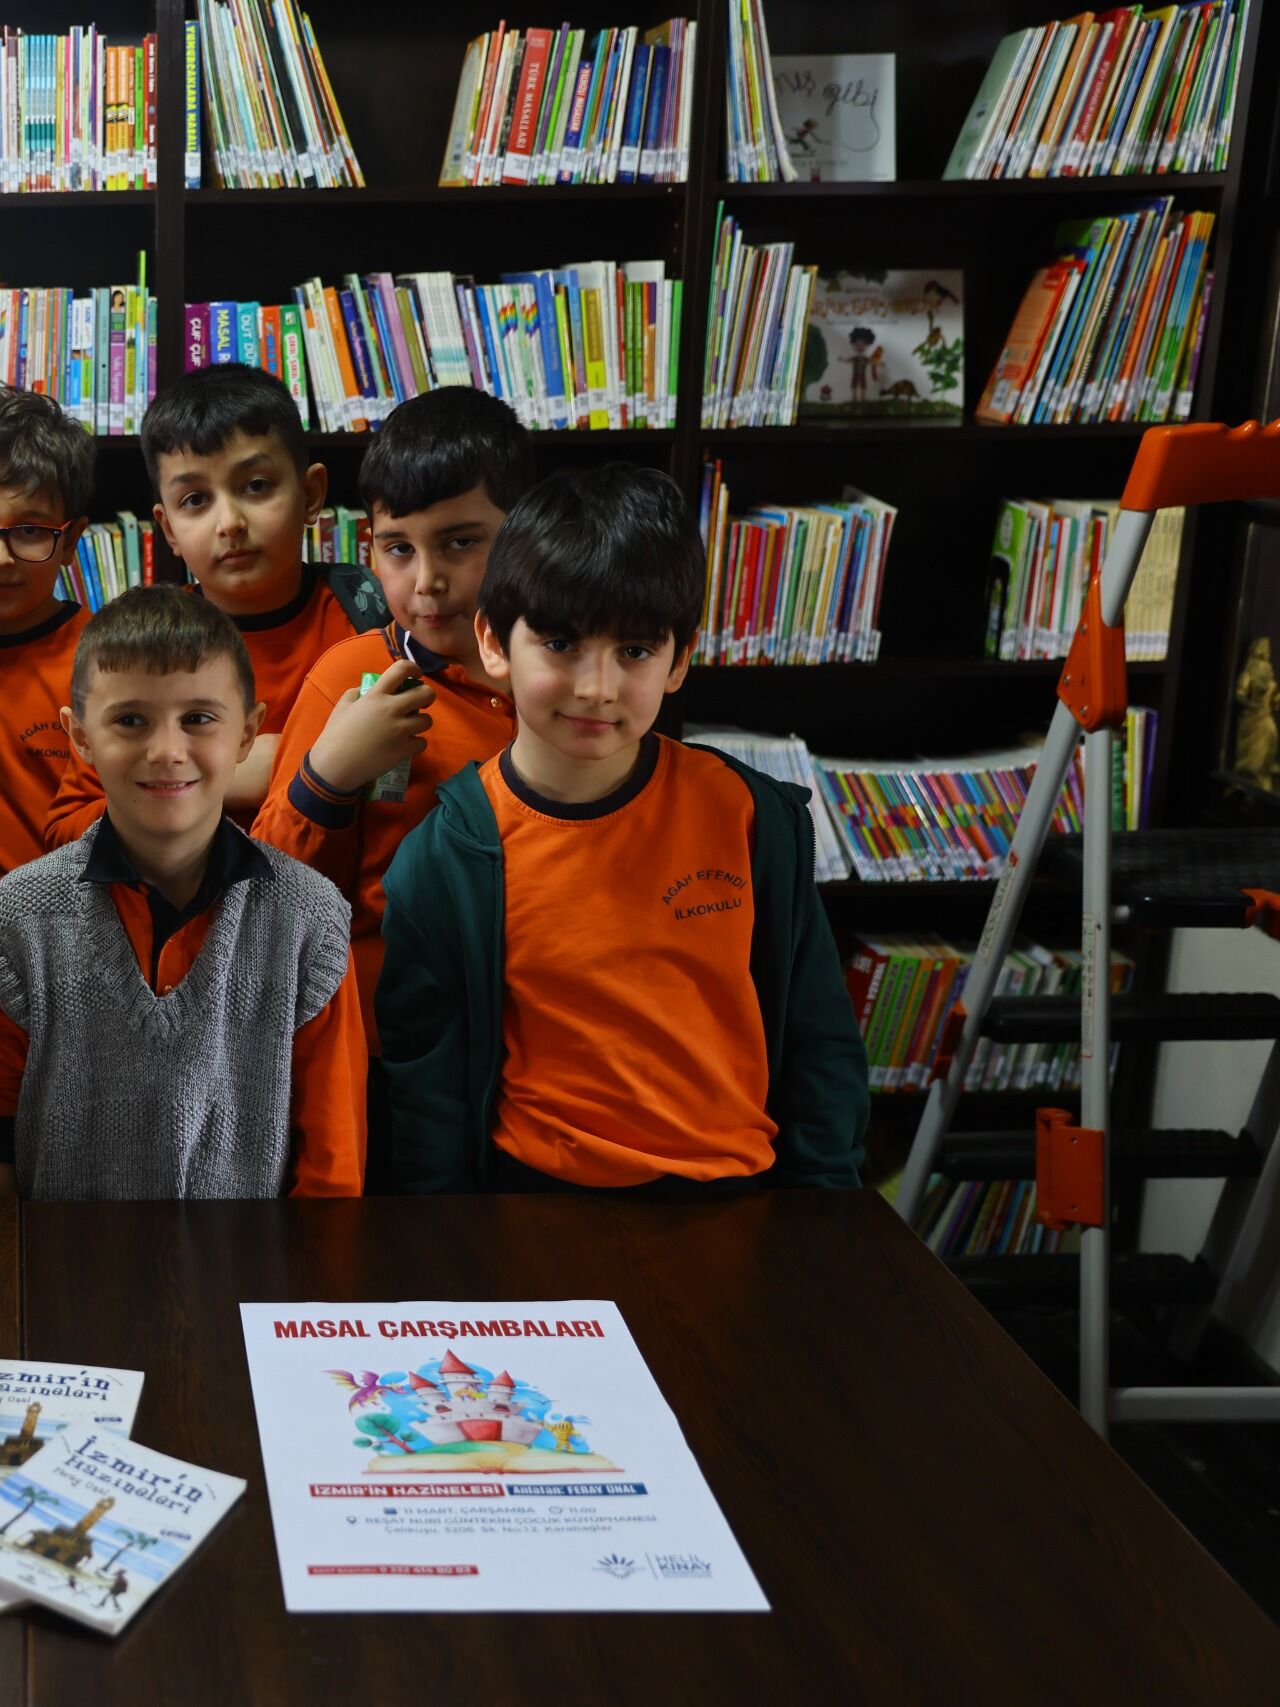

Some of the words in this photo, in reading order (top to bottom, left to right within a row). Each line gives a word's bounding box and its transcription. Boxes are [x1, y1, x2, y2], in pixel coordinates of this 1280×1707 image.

[190, 318, 201, 341] ÇUF
[216, 309, 230, 351] MASAL
[190, 344, 201, 367] ÇUF
[274, 1320, 371, 1338] MASAL
[378, 1319, 605, 1340] ÇARŞAMBALARI
[73, 1435, 204, 1503] İzmir'in
[64, 1454, 193, 1515] Hazineleri
[314, 1484, 387, 1496] İZMİR'İN
[393, 1484, 500, 1495] HAZİNELERİ
[513, 1484, 566, 1494] Anlatan:
[569, 1484, 603, 1494] FERAY
[460, 1507, 535, 1515] ÇARŞAMBA
